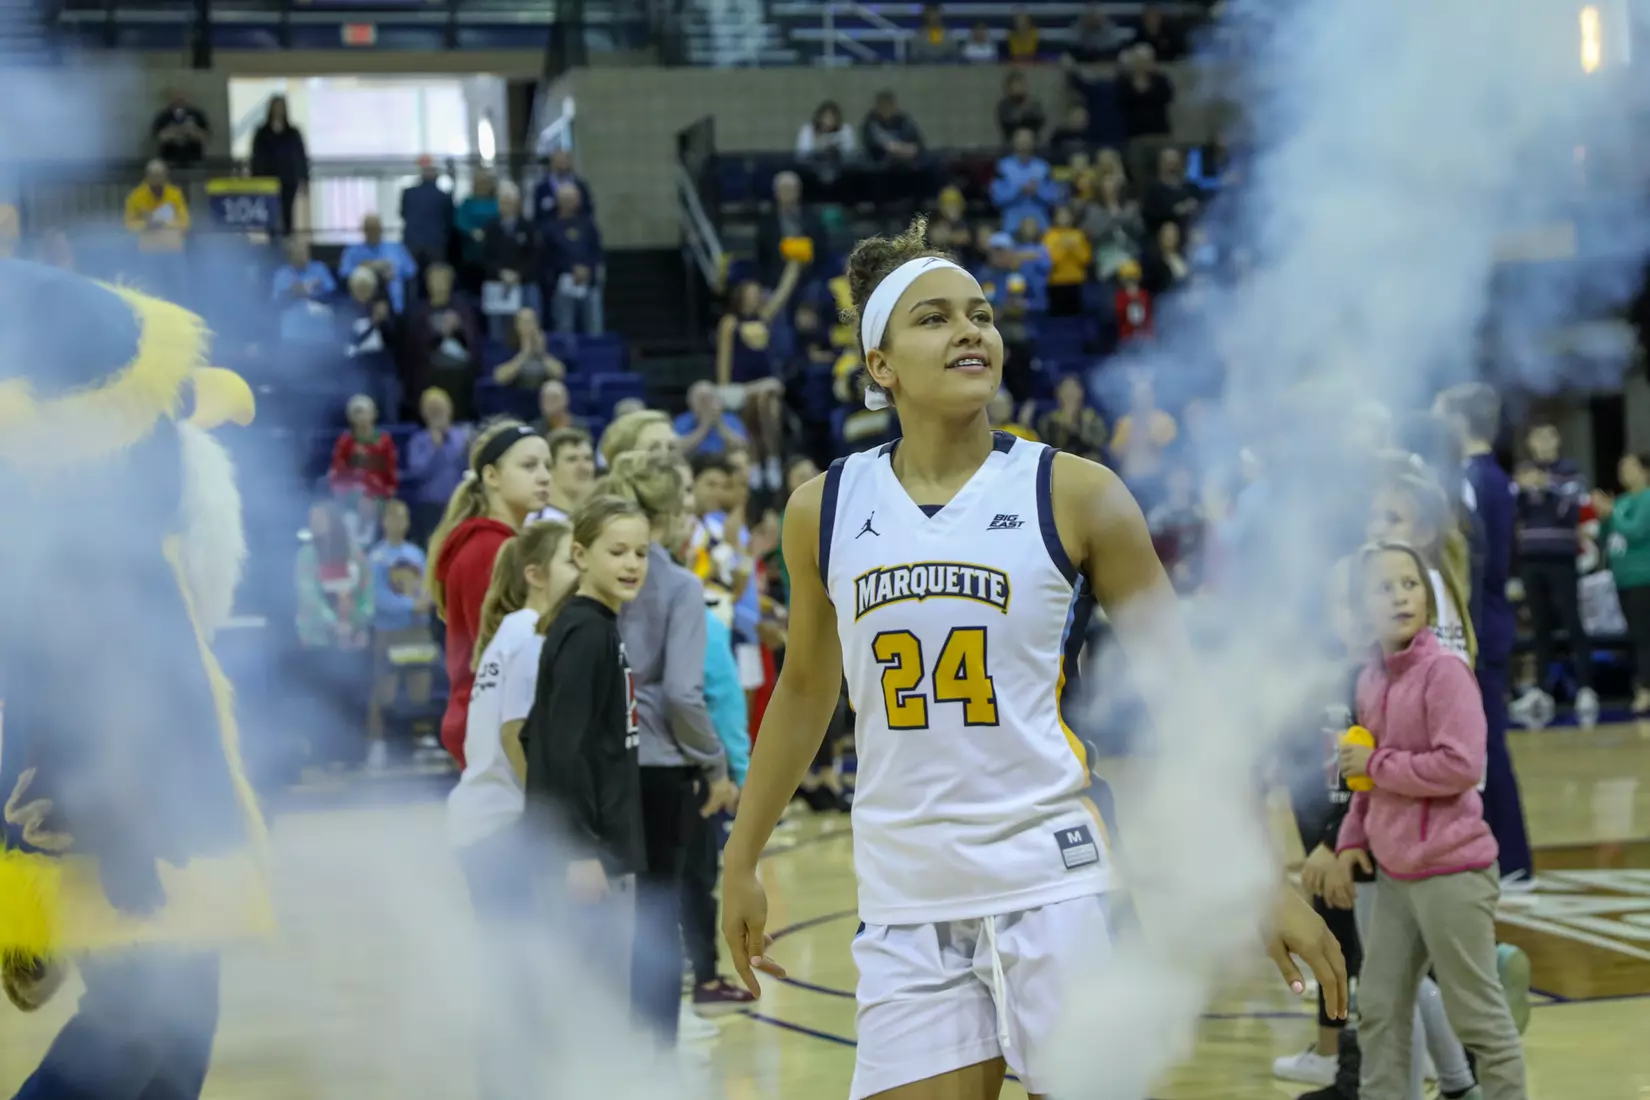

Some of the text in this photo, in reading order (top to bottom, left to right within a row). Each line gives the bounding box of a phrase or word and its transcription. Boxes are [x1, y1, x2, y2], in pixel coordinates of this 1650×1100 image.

[223, 196, 269, 224] 104
[989, 520, 1025, 528] EAST
[993, 513, 1019, 521] BIG
[854, 562, 1011, 620] MARQUETTE
[871, 626, 1000, 730] 24
[1066, 830, 1083, 844] M
